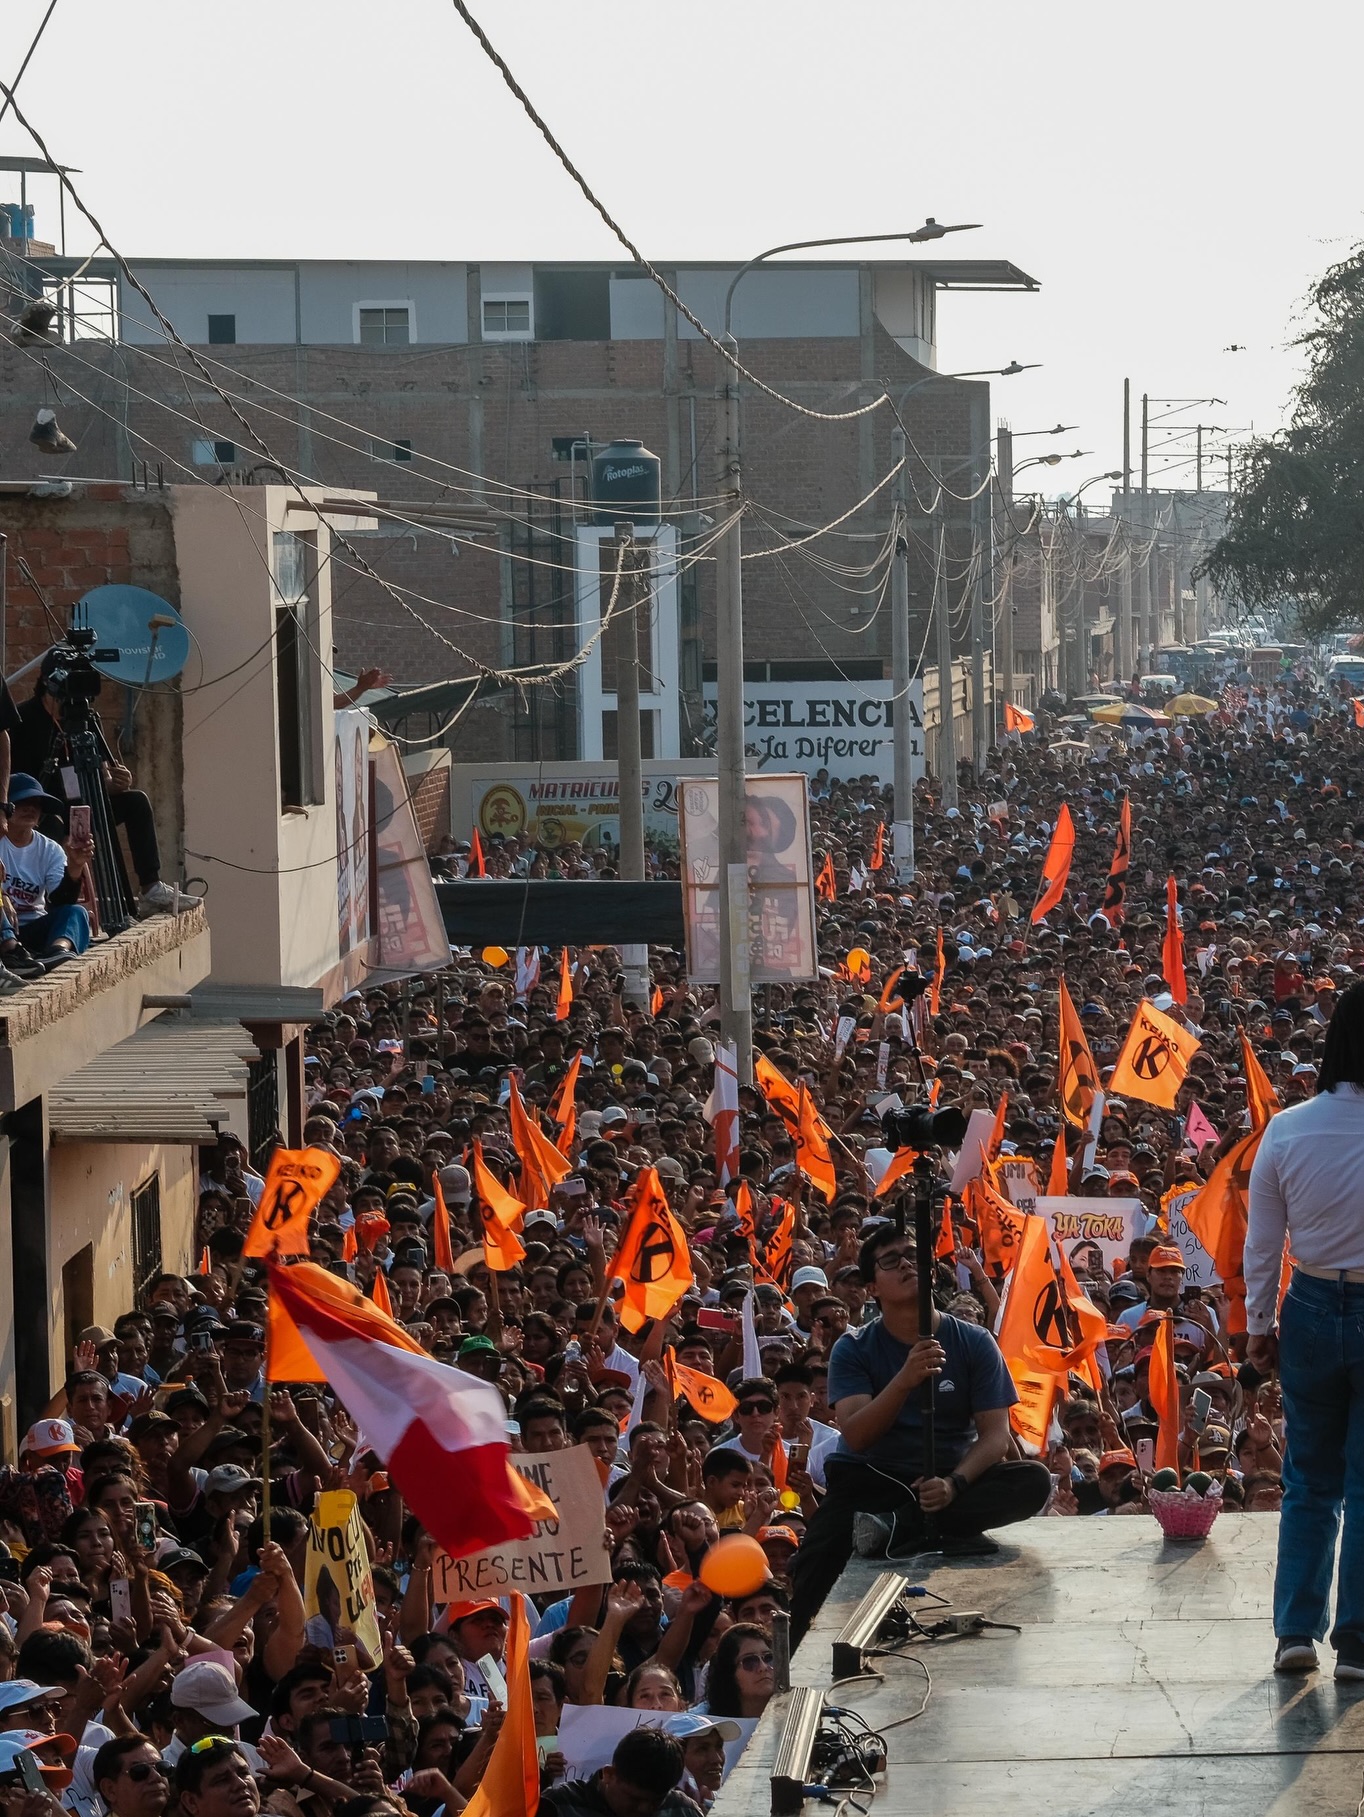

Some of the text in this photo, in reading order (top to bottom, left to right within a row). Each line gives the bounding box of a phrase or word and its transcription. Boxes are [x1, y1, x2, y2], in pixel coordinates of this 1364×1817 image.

[606, 465, 644, 481] Rotoplas
[1140, 1017, 1179, 1053] KEIKO
[1135, 1036, 1168, 1080] K
[1052, 1212, 1124, 1242] YA TOKA
[50, 1423, 66, 1441] K
[436, 1547, 588, 1595] PRESENTE
